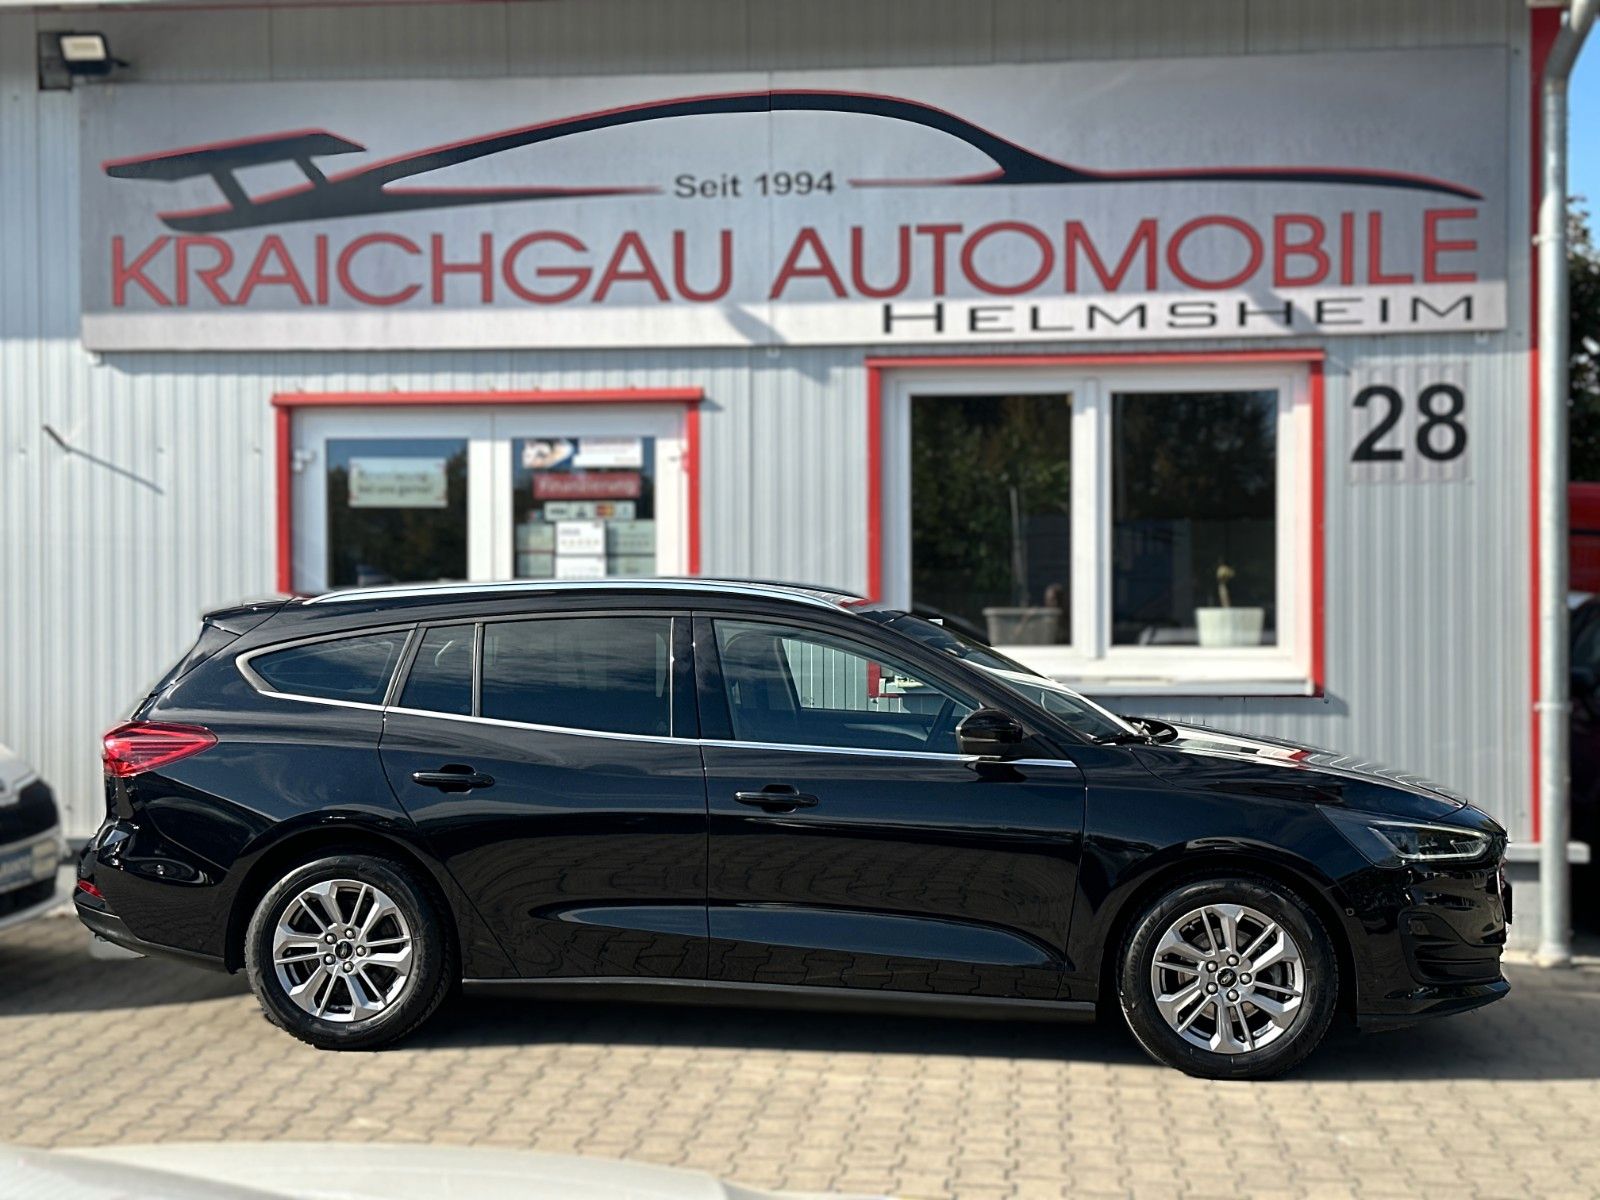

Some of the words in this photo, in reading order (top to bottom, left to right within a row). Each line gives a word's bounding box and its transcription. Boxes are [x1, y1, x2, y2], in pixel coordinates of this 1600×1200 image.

[677, 172, 741, 199] Seit
[758, 171, 836, 197] 1994
[111, 229, 734, 306] KRAICHGAU
[769, 208, 1478, 300] AUTOMOBILE
[883, 295, 1474, 334] HELMSHEIM
[1350, 382, 1469, 463] 28
